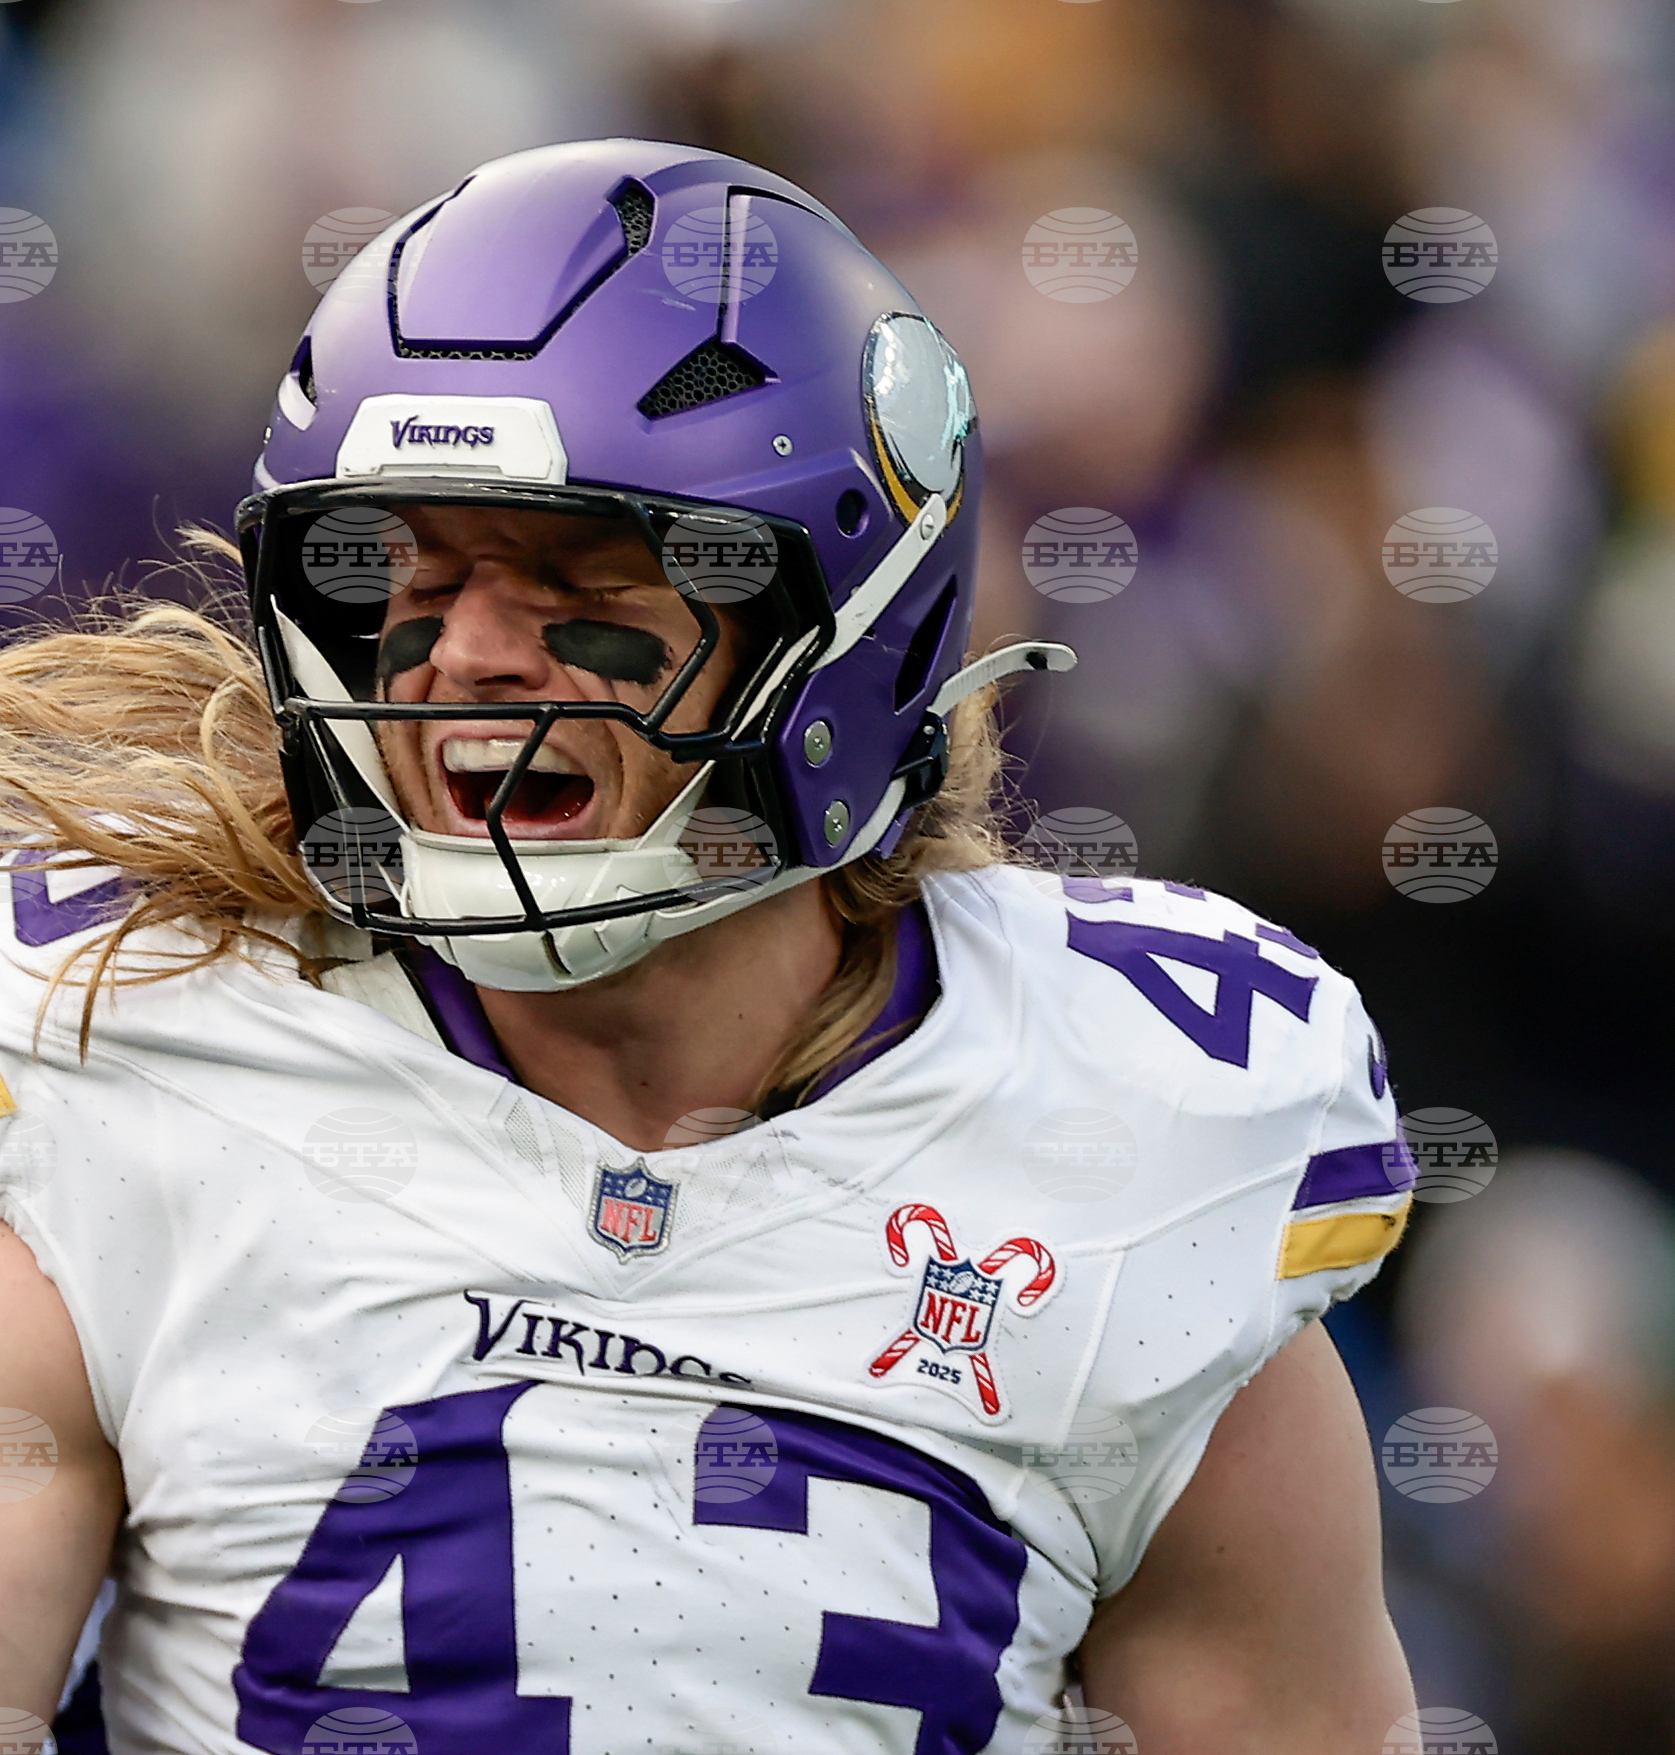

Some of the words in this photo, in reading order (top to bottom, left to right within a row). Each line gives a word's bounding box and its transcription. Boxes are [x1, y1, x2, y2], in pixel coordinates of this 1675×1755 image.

[599, 1198, 658, 1244] NFL
[920, 1291, 982, 1345] NFL
[916, 1357, 962, 1386] 2025
